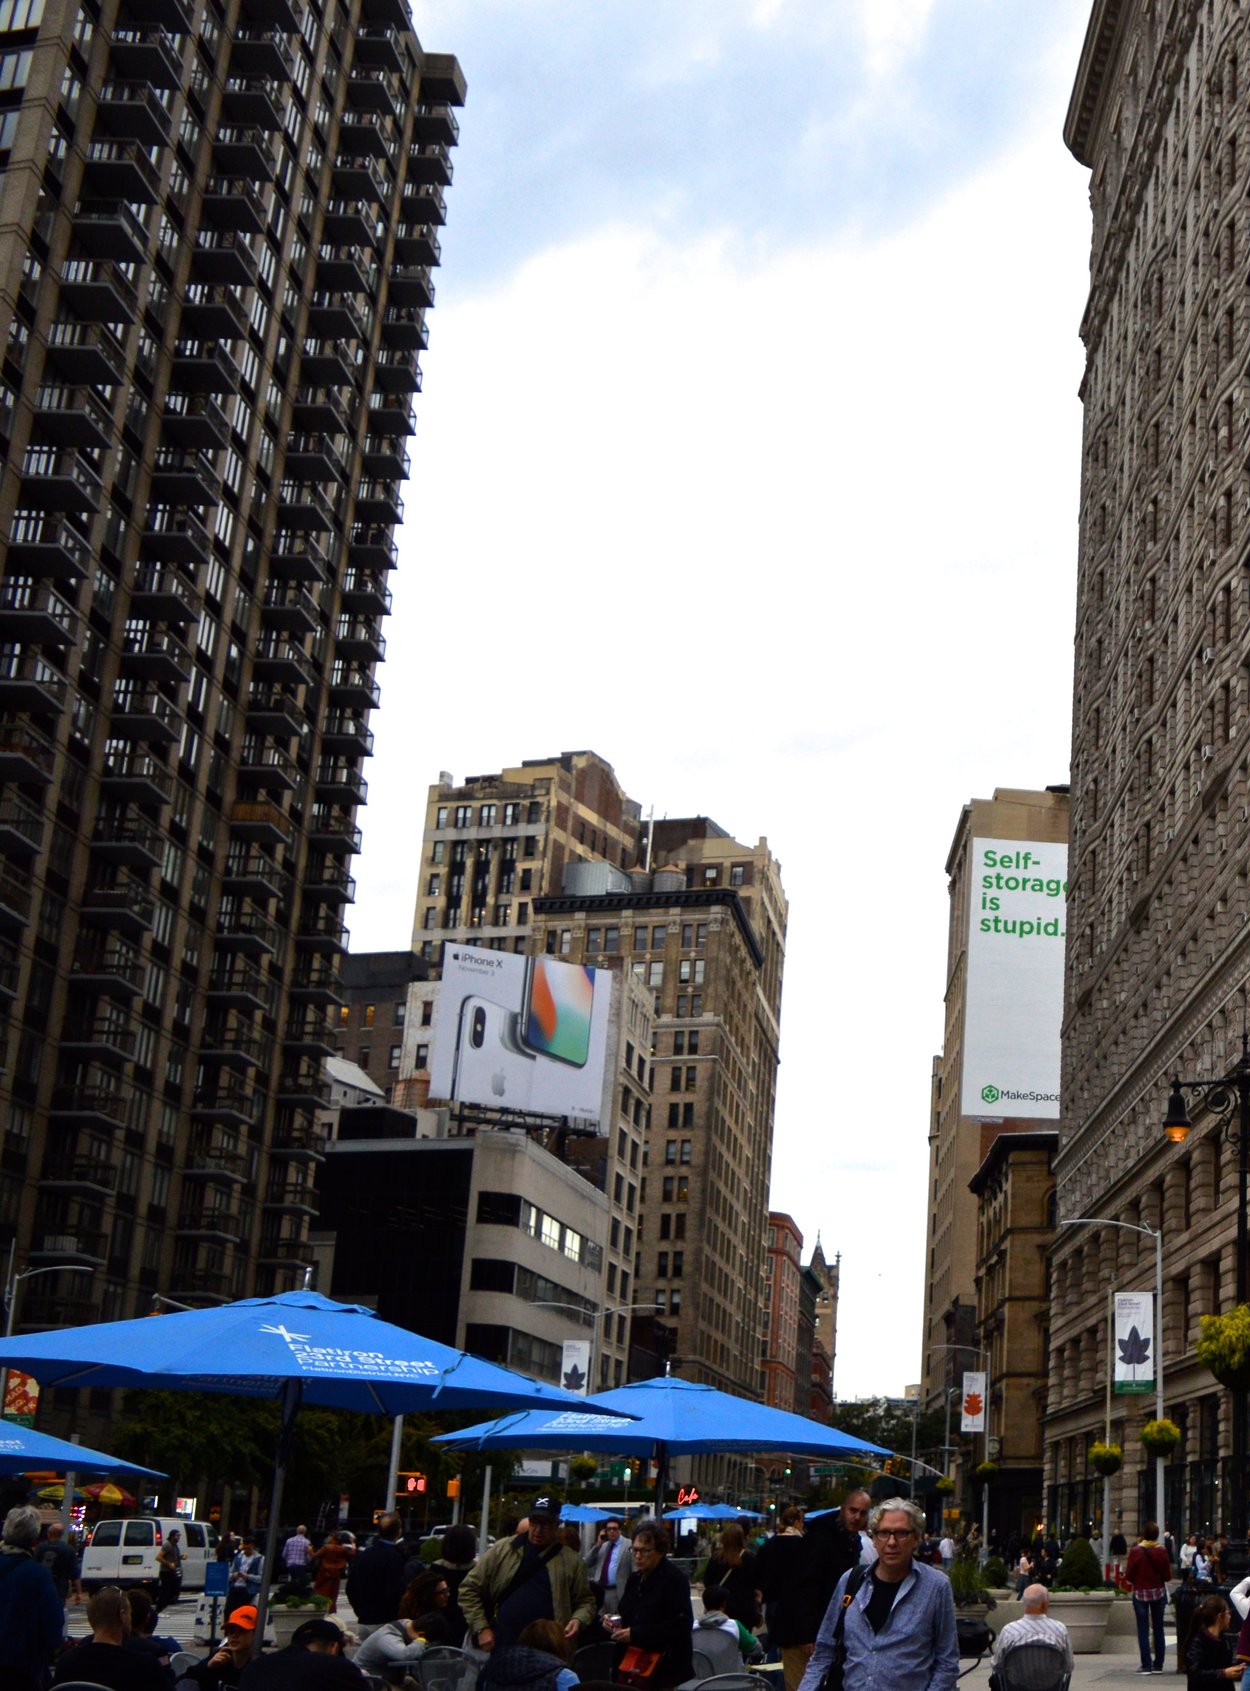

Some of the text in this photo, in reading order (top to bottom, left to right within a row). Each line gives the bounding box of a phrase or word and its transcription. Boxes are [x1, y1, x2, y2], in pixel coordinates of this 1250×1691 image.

[983, 850, 1040, 869] Self-
[981, 892, 1000, 911] is
[979, 915, 1066, 938] stupid.
[461, 952, 503, 968] iPhone X
[288, 1343, 384, 1358] Flatiron
[294, 1351, 436, 1368] 23rd Street
[297, 1358, 439, 1376] Partnership
